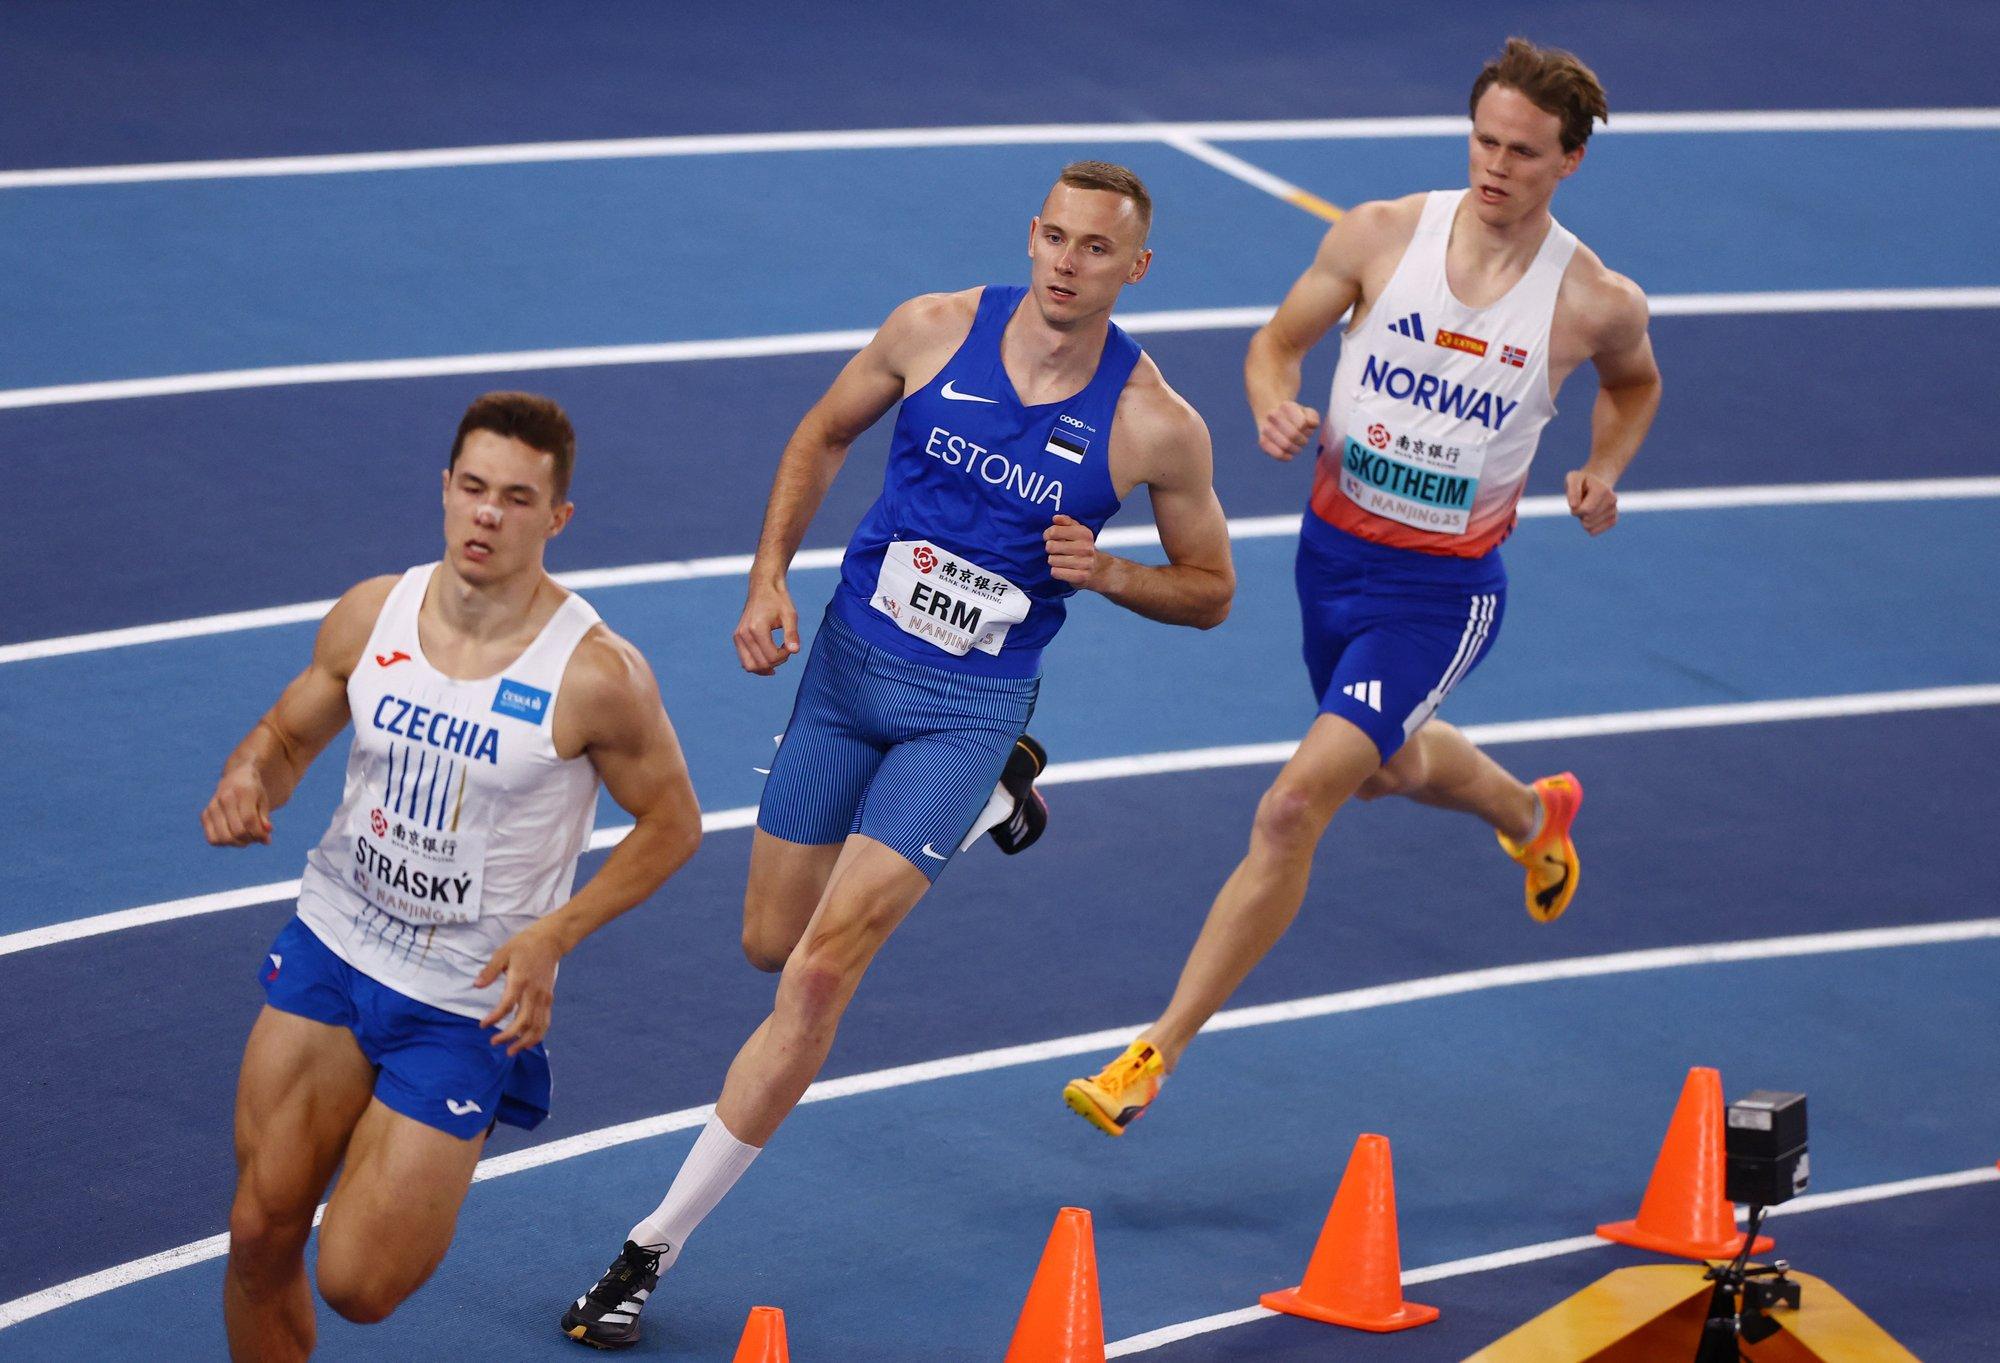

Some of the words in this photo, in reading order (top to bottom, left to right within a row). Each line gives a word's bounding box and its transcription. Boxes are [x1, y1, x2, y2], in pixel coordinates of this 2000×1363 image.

[1361, 354, 1518, 430] NORWAY
[1060, 414, 1084, 429] coop
[925, 426, 1063, 511] ESTONIA
[1348, 443, 1469, 506] SKOTHEIM
[1371, 494, 1440, 524] NANJING
[1441, 513, 1460, 526] 25
[939, 574, 958, 587] BANK
[972, 588, 1002, 605] NANJING
[941, 561, 1008, 596] 南京银行
[909, 581, 982, 635] ERM
[980, 632, 994, 645] 5
[372, 694, 499, 765] CZECHIA
[355, 836, 472, 905] STRÁSKÝ
[376, 888, 444, 921] NANJING
